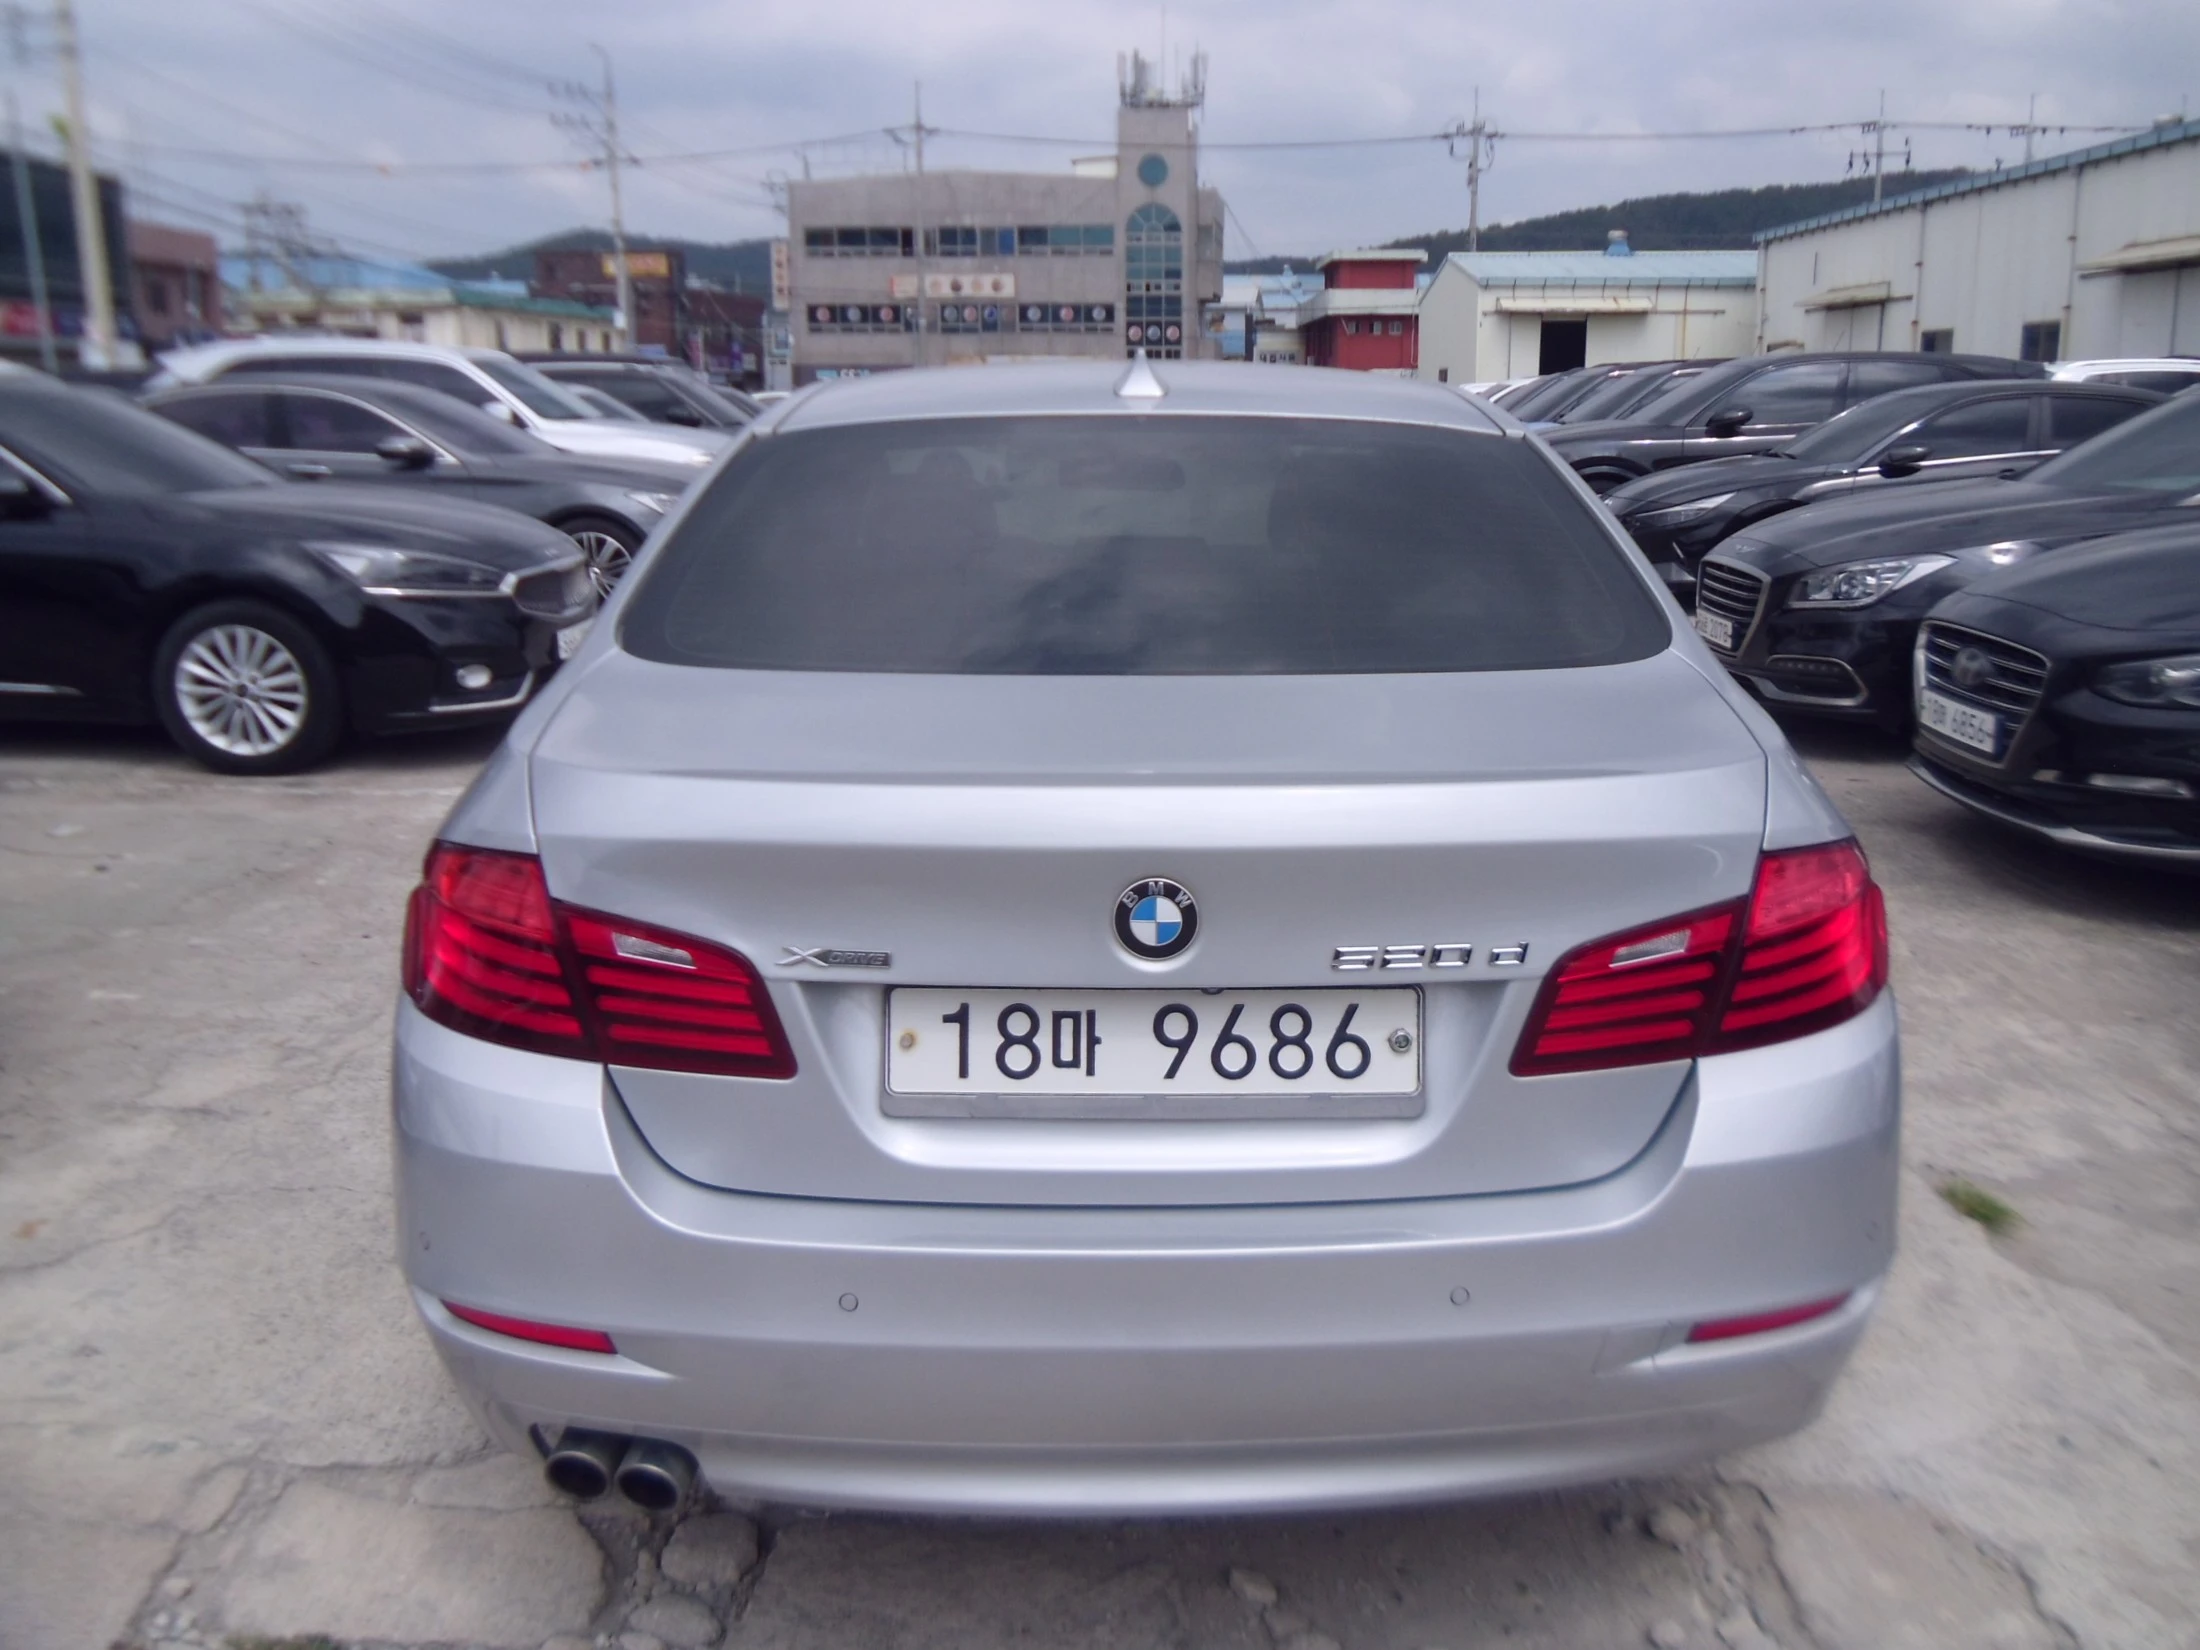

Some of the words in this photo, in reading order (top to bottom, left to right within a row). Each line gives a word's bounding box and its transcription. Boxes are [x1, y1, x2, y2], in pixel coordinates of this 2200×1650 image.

[1122, 881, 1192, 909] BMW
[942, 1002, 1102, 1080] 18마
[1152, 1003, 1372, 1080] 9686
